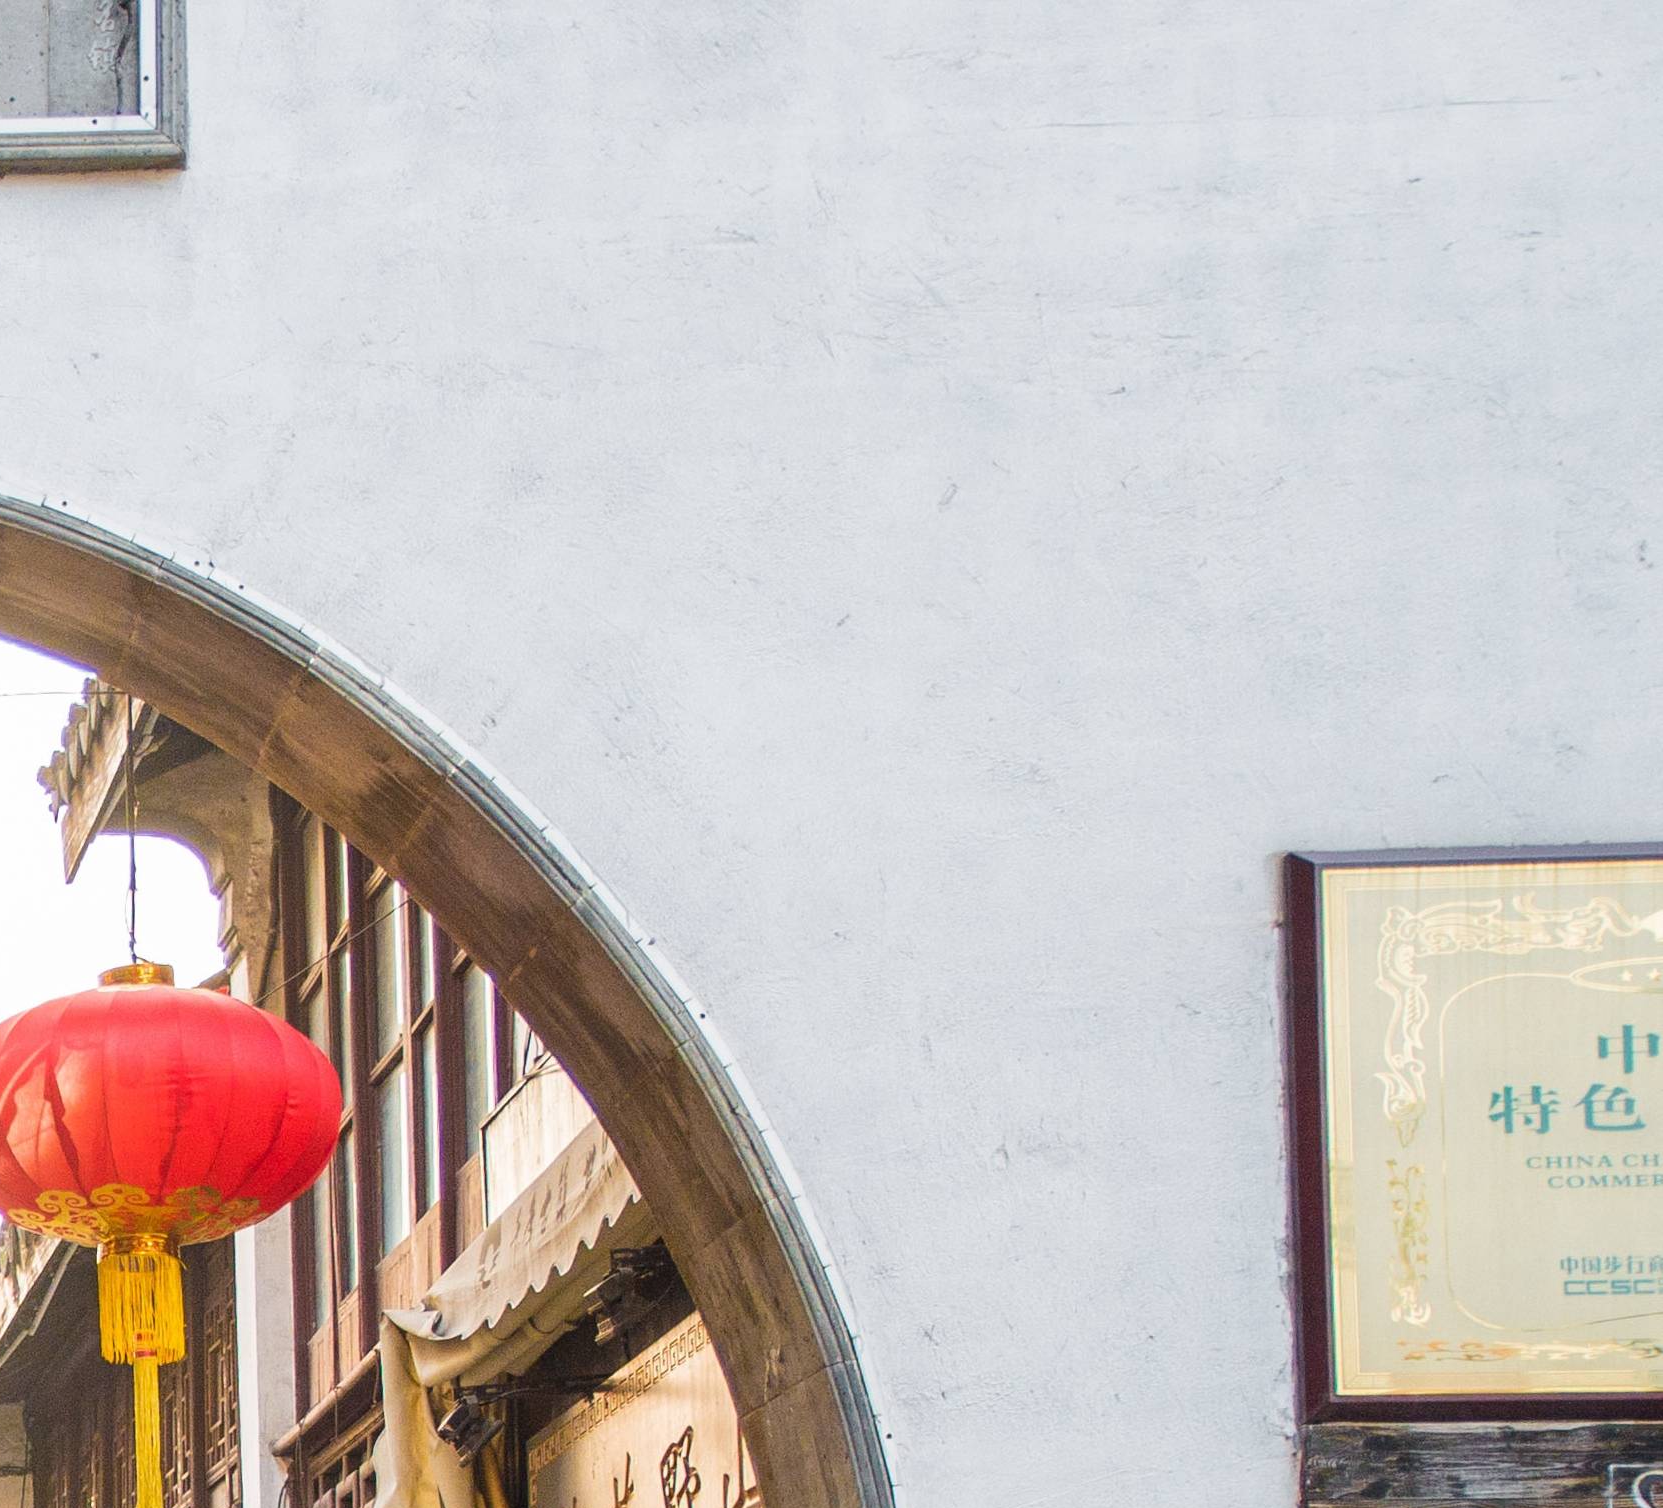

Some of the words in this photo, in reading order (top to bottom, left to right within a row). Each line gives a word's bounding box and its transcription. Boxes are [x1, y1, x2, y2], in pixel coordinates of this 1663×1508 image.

[1597, 1023, 1660, 1074] 中
[1488, 1083, 1647, 1135] 特色
[1526, 1154, 1613, 1169] CHINA
